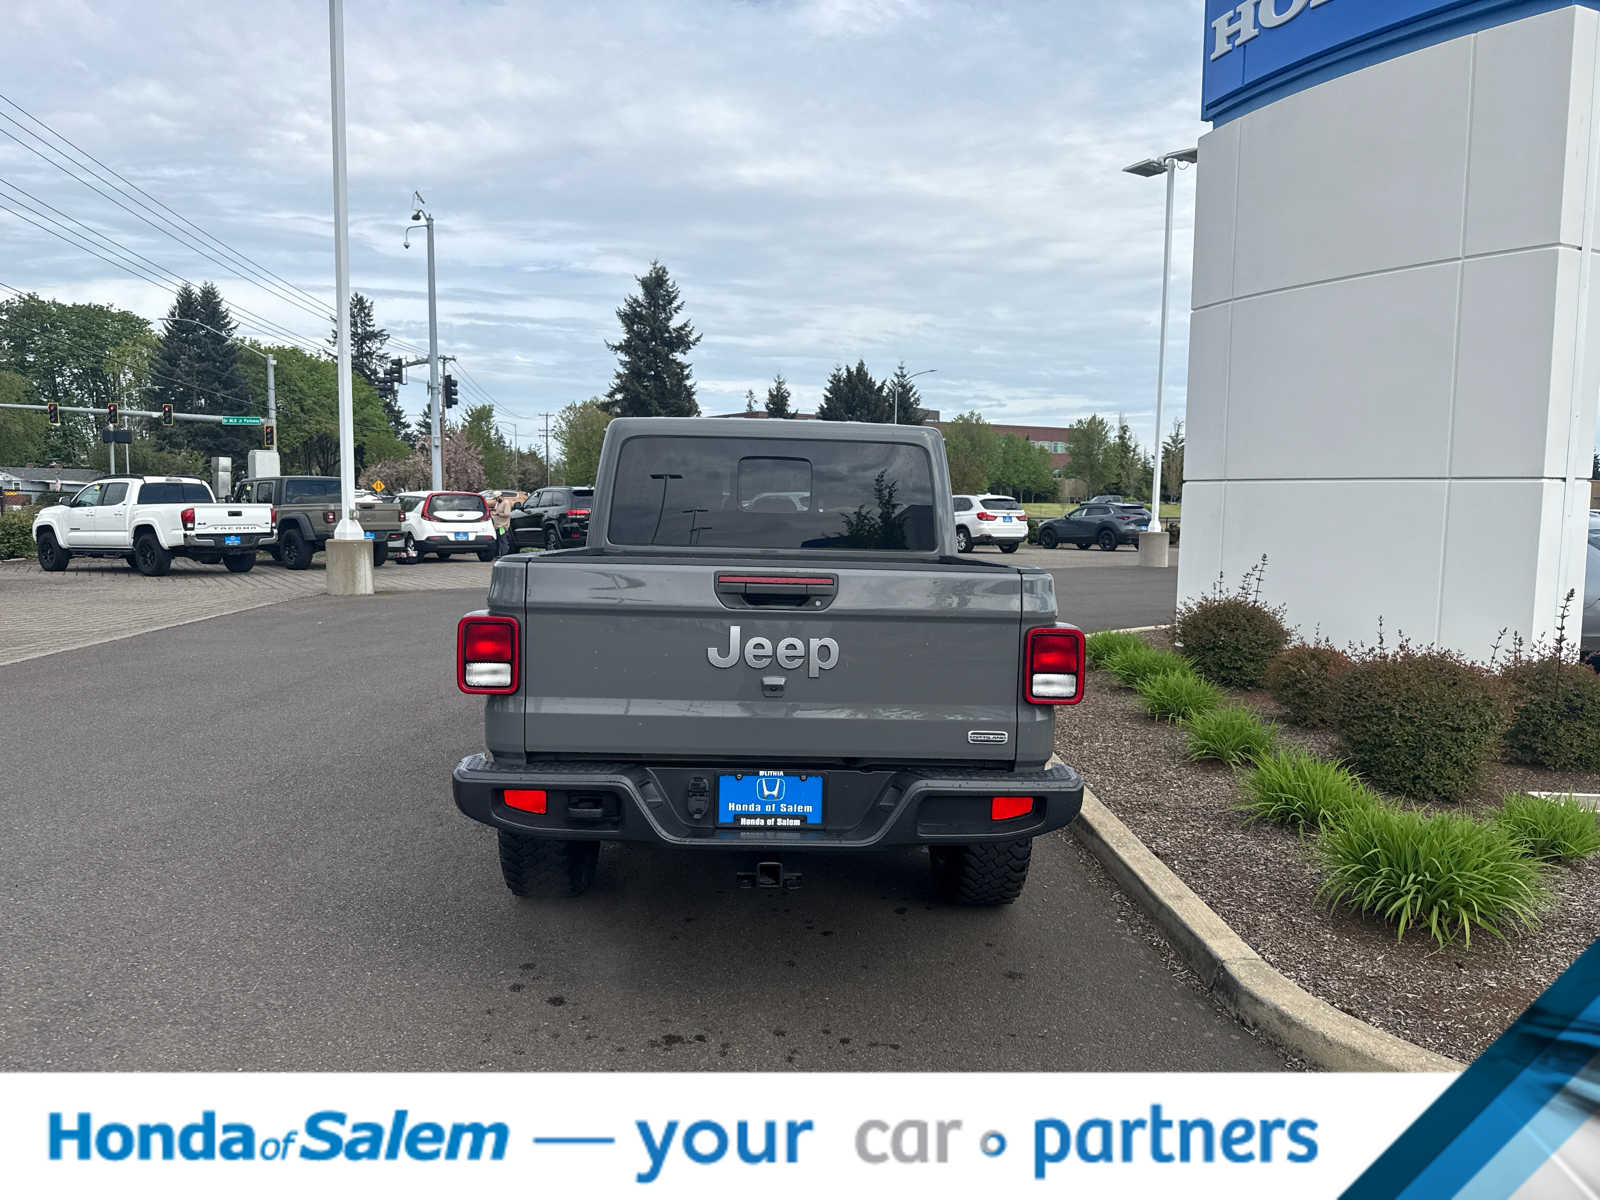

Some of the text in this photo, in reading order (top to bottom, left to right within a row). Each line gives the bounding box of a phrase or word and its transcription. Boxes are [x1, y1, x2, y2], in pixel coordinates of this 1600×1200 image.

[1210, 0, 1335, 62] HO
[707, 625, 840, 679] Jeep
[728, 802, 813, 813] Honda of Salem
[740, 817, 801, 826] Honda of Salem
